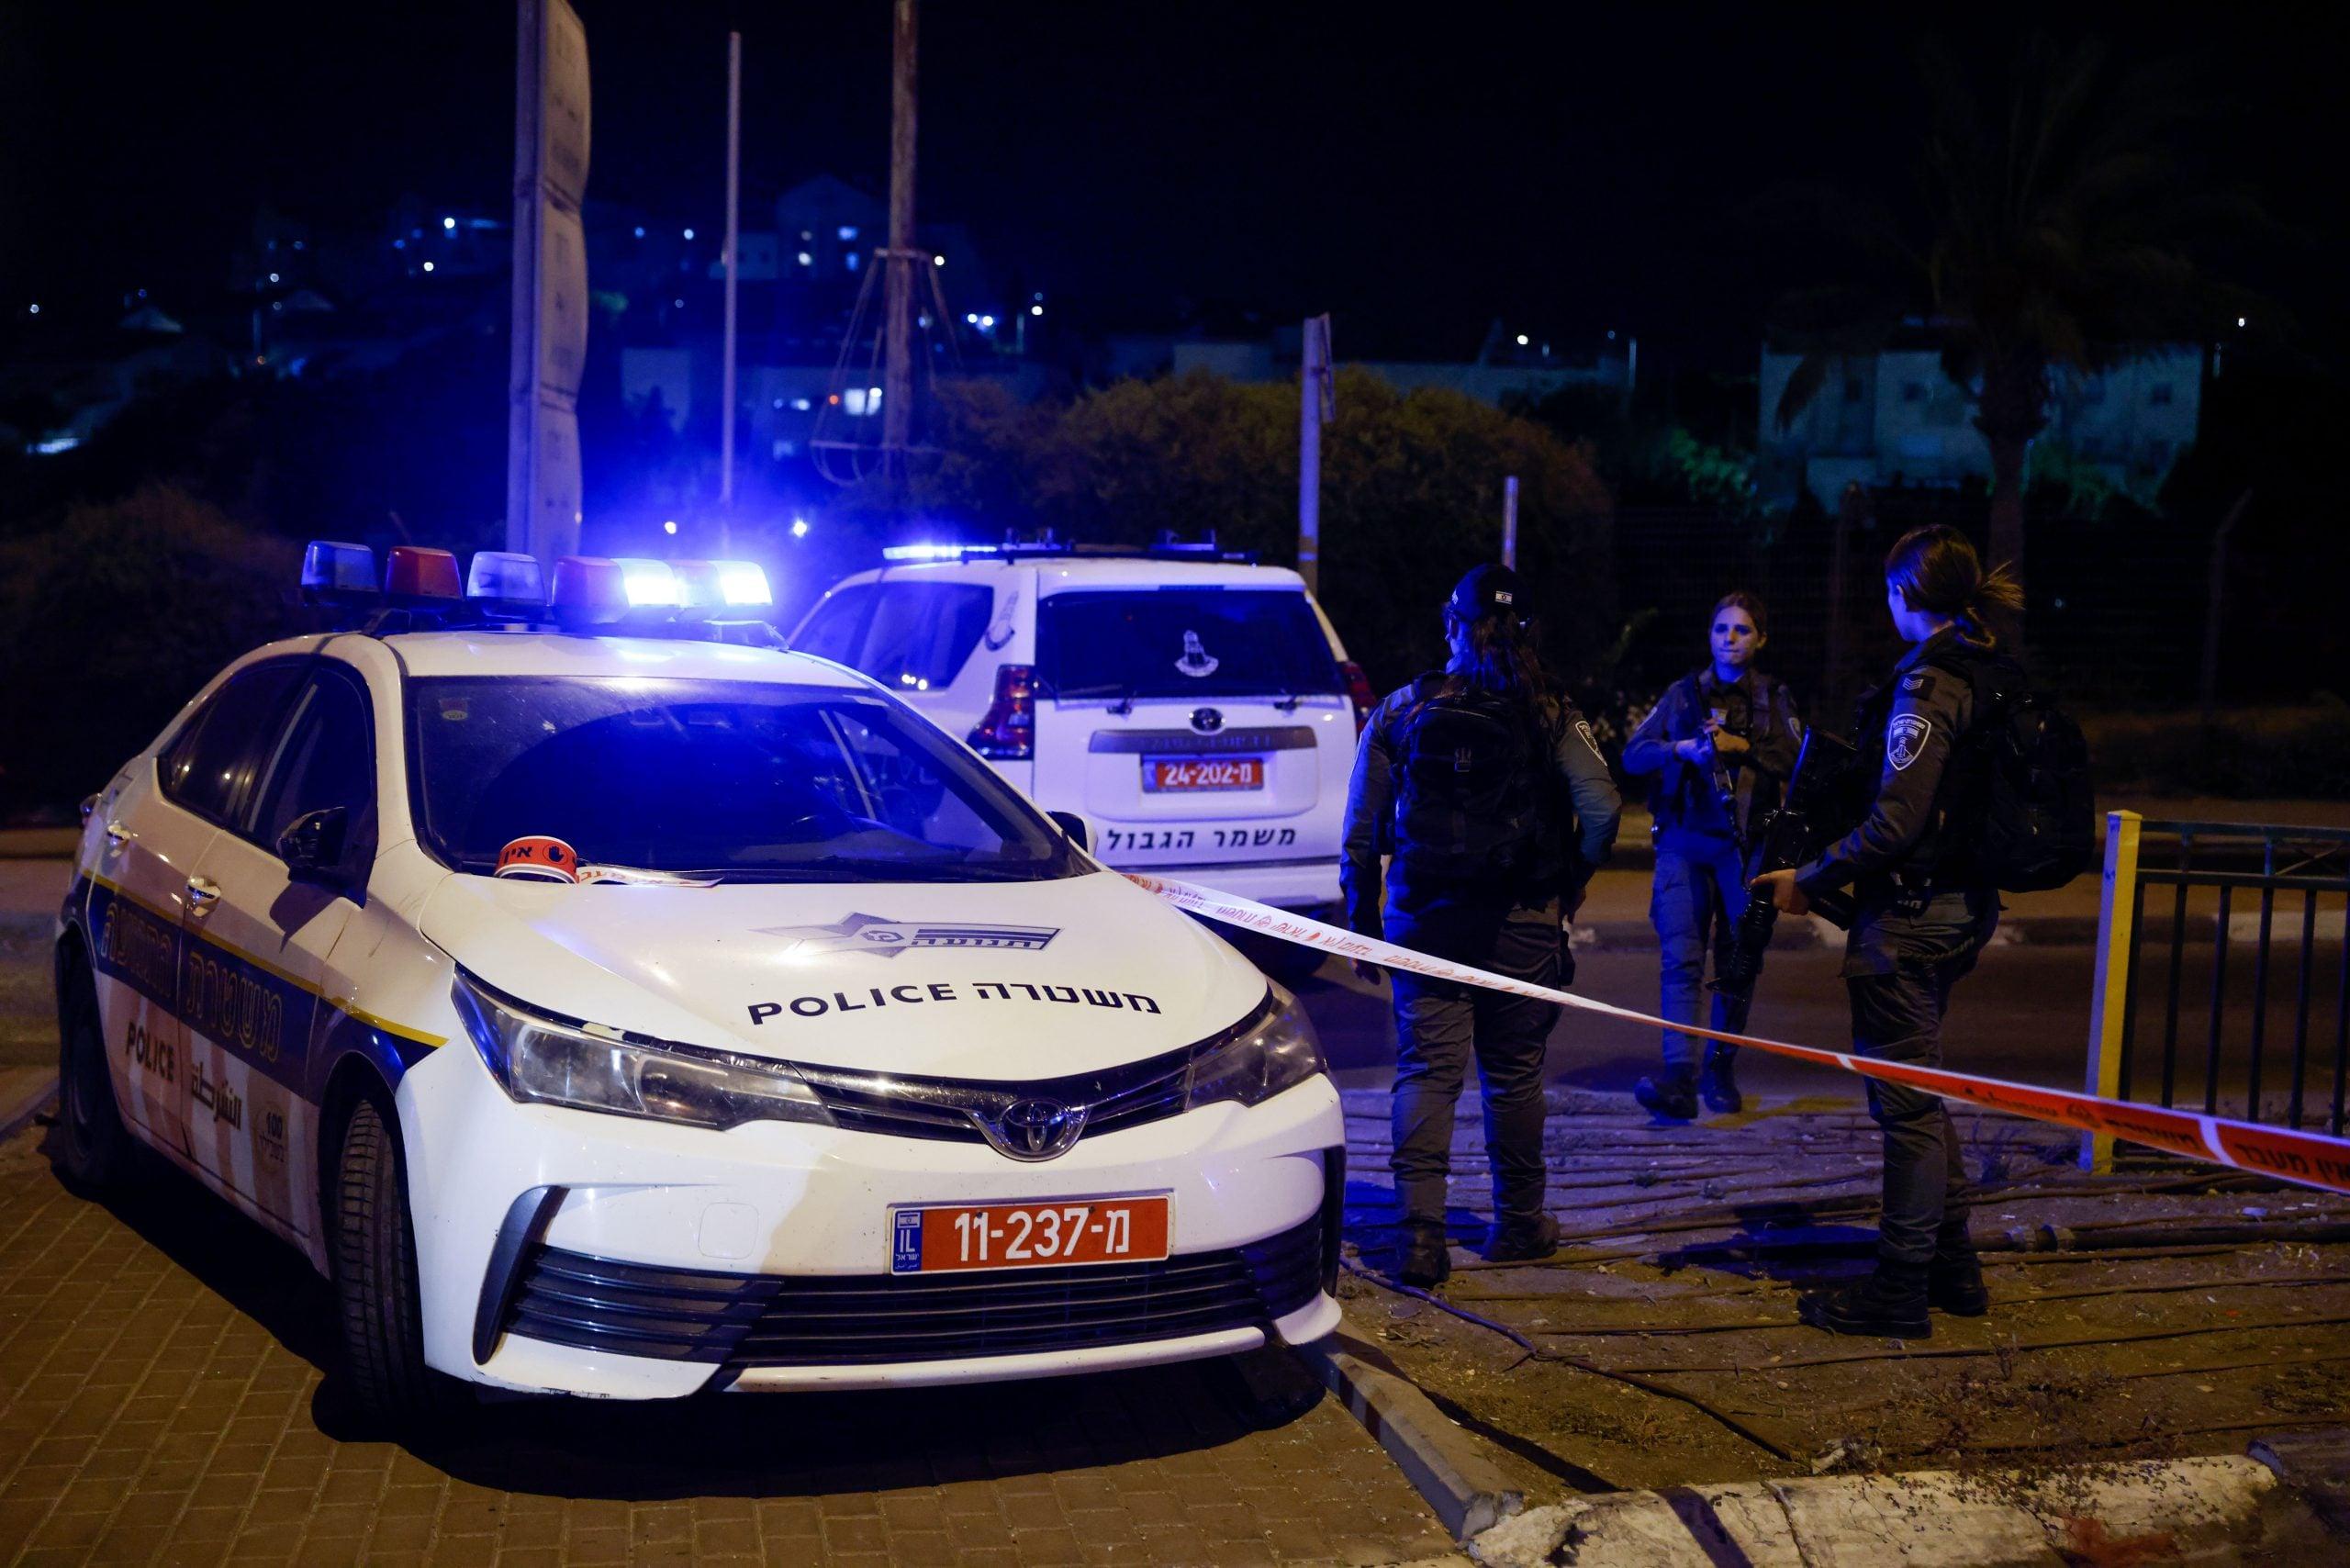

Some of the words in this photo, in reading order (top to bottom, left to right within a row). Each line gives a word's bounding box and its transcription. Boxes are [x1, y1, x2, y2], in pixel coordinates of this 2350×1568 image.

[1107, 829, 1195, 850] הגבול
[1213, 827, 1297, 848] משמר
[747, 982, 957, 1025] POLICE
[972, 981, 1162, 1014] משטרה
[126, 1020, 174, 1082] POLICE
[900, 1229, 915, 1253] IL
[955, 1207, 1130, 1262] 11-237-מ
